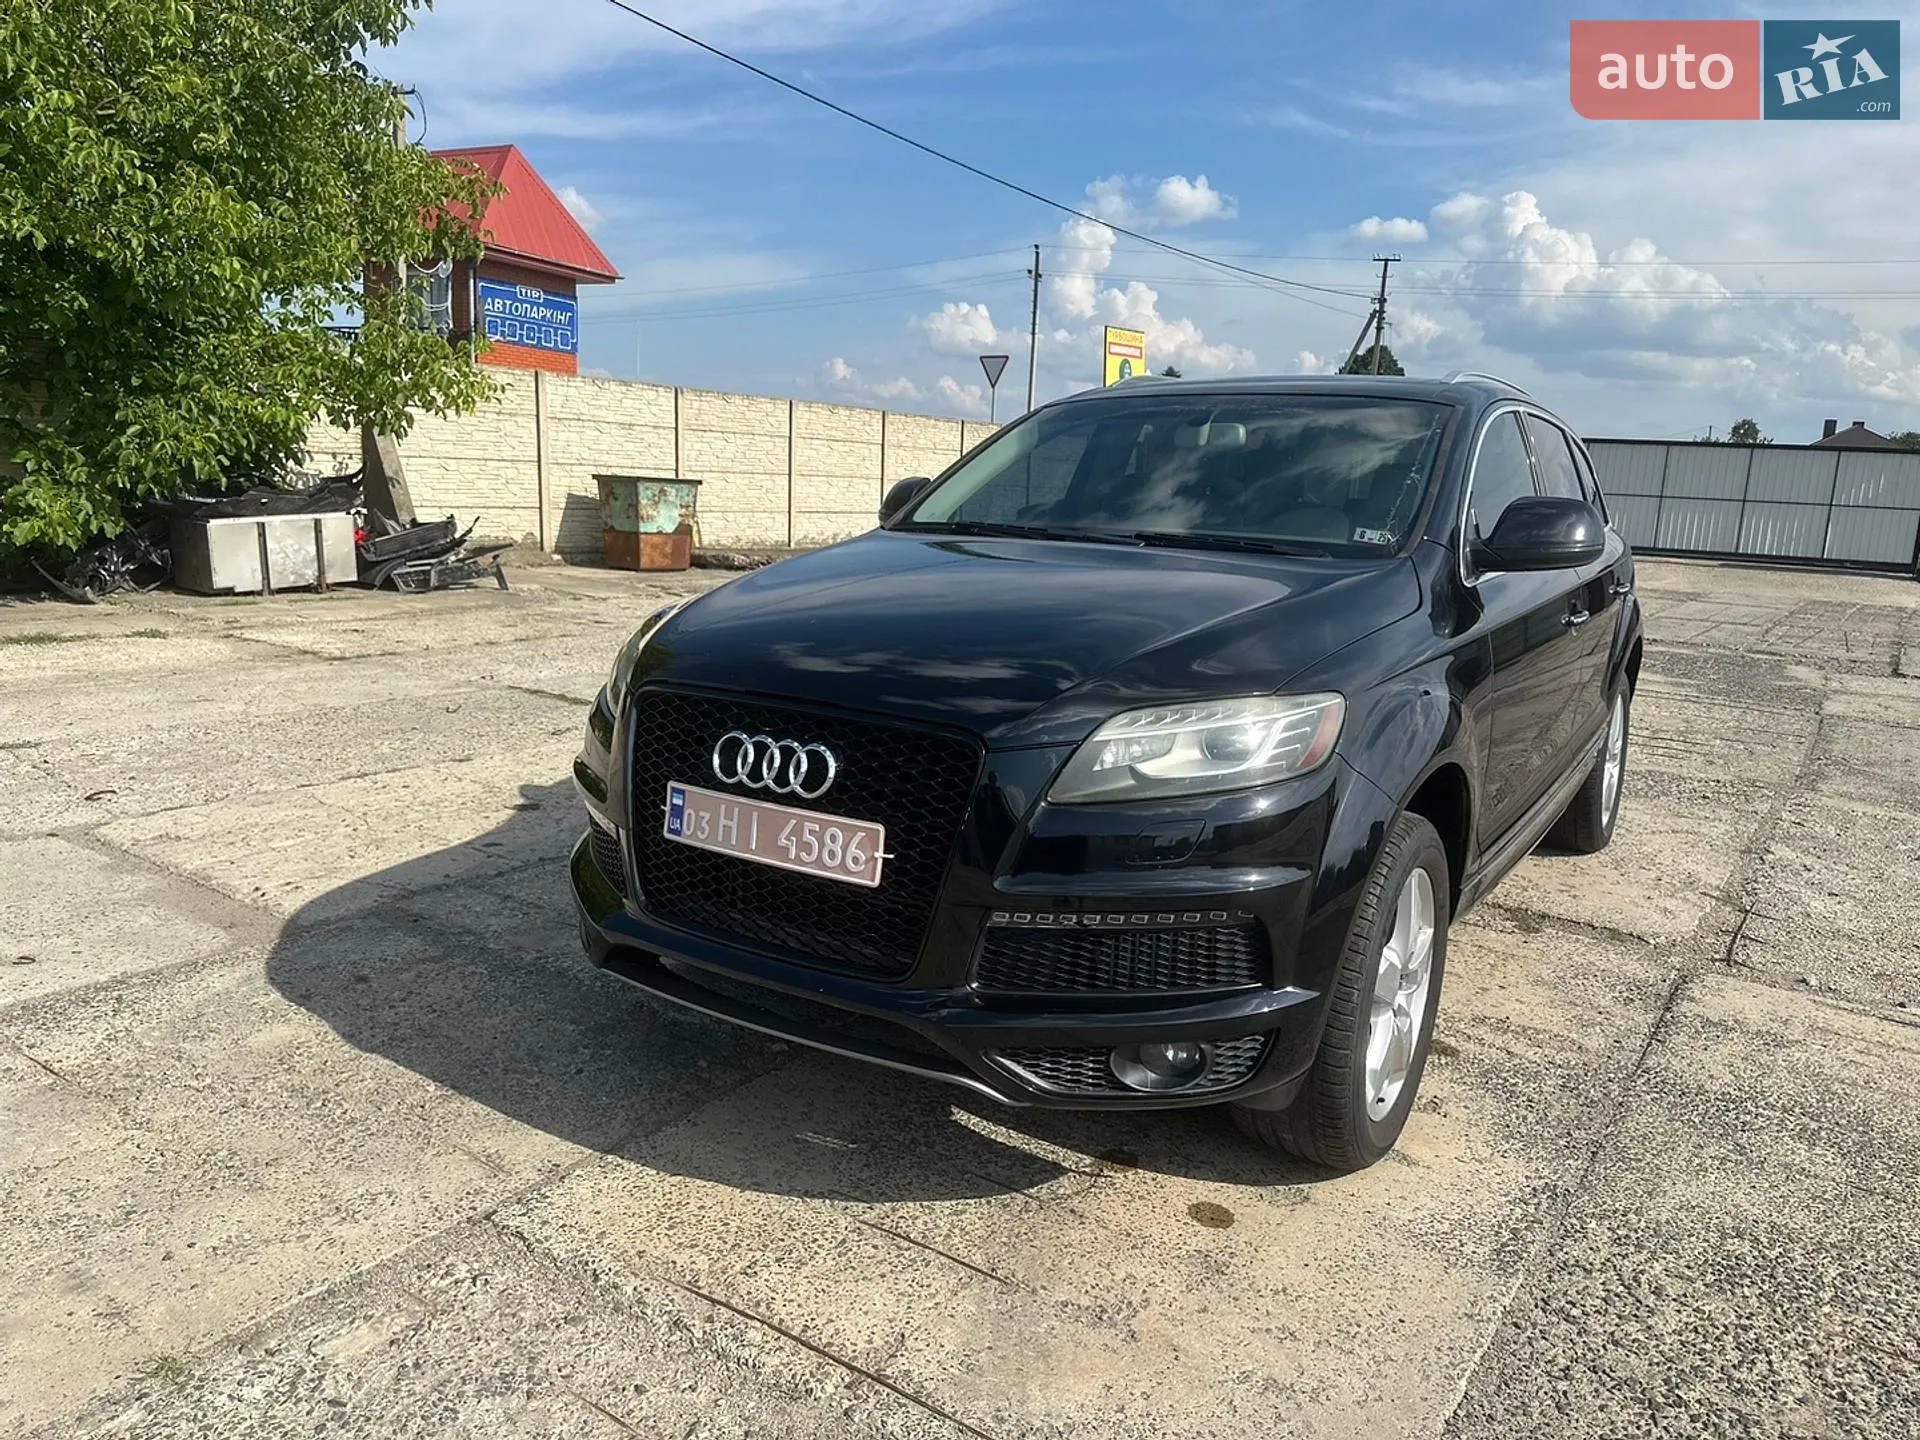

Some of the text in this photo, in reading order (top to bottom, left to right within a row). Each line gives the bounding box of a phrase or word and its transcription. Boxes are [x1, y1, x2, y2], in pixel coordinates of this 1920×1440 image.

[519, 288, 540, 298] TIR
[484, 297, 573, 326] АВТОПАРКІНГ
[670, 816, 682, 831] UA
[777, 818, 867, 873] 4586
